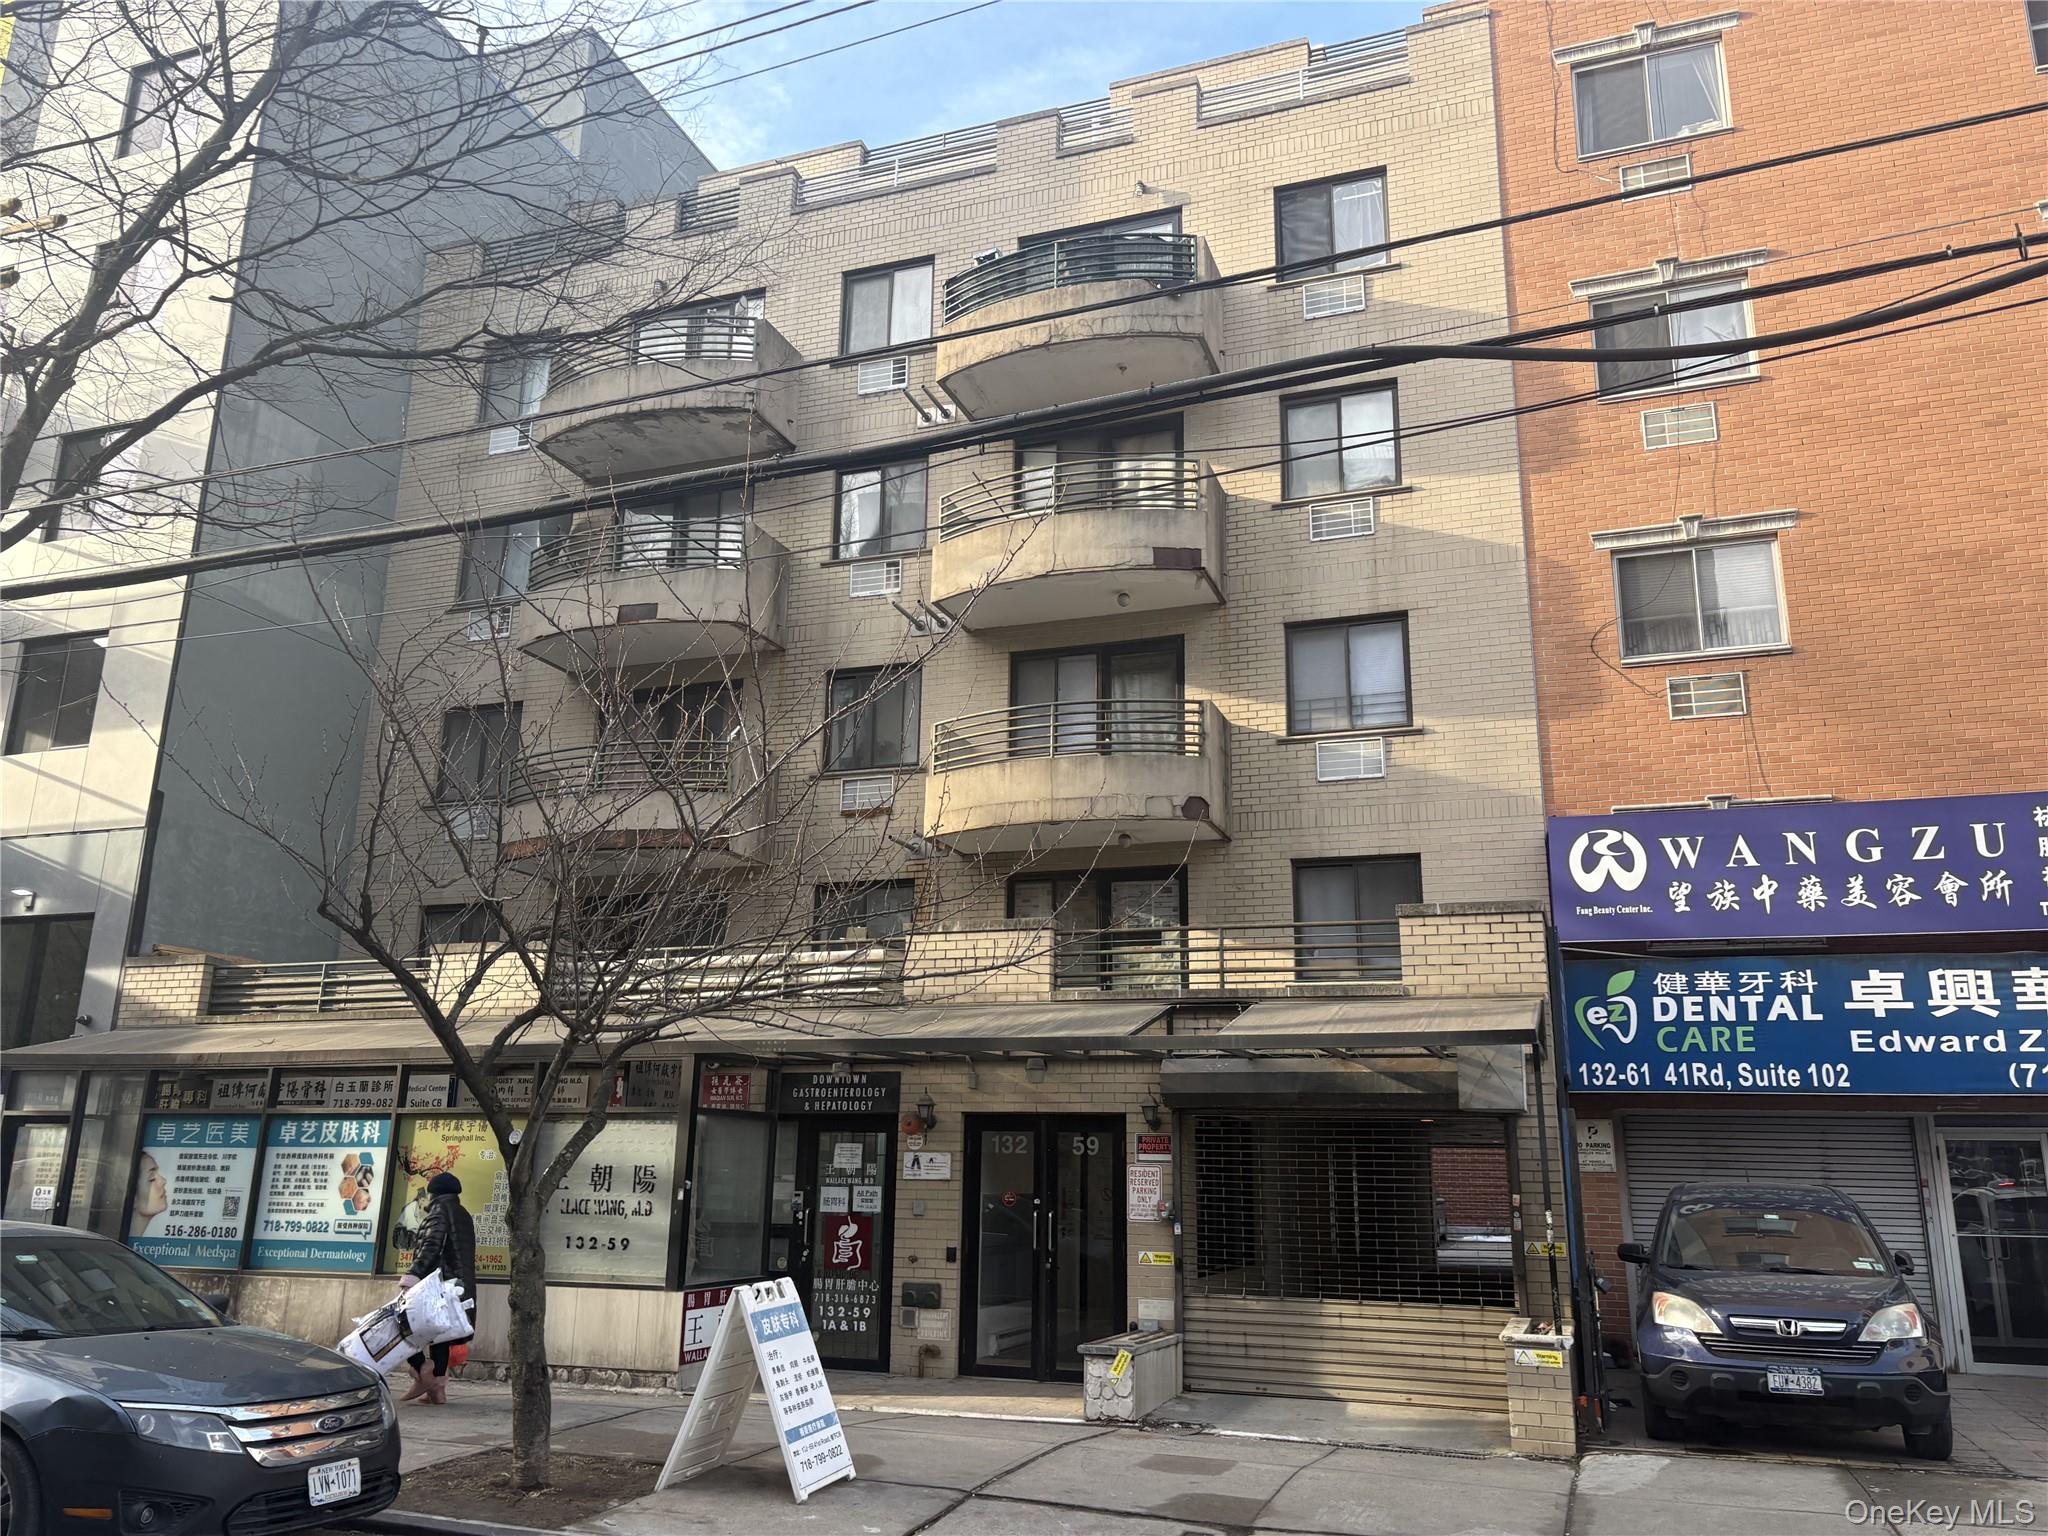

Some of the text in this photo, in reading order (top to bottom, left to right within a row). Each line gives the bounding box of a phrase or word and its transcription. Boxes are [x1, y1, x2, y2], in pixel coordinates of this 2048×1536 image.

[1658, 822, 2006, 870] WANGZU
[1668, 869, 2013, 915] 望族中藥美容會所
[1576, 904, 1653, 917] Fang Beauty Center Inc.
[1653, 969, 1818, 995] 健華牙科
[1653, 994, 1824, 1022] DENTAL
[1656, 1026, 1756, 1053] CARE
[1850, 1029, 2007, 1053] Edward
[813, 1074, 868, 1085] DOWNTOWN
[1578, 1062, 1851, 1091] 132-61 41Rd, Suite 102
[335, 1080, 394, 1093] 白玉蘭診所
[792, 1087, 887, 1098] GASTROENTEROLOGY
[410, 1098, 430, 1108] Suite
[804, 1101, 873, 1111] & HEPATOLOGY
[156, 1121, 250, 1144] 卓艺医美
[278, 1120, 381, 1144] 卓艺皮肤科
[441, 1134, 474, 1143] Springhall
[991, 1135, 1099, 1156] 132 59
[1141, 1136, 1169, 1144] PRIVATE
[1130, 1169, 1159, 1178] RESIDENT
[1129, 1178, 1160, 1186] RESERVED
[1132, 1187, 1157, 1195] PARKING
[1137, 1195, 1152, 1204] ONLY
[164, 1224, 238, 1239] 516-286-0180
[263, 1220, 330, 1233] 718-799-0822
[565, 1235, 630, 1251] 132-59
[133, 1242, 236, 1262] Exceptional Medspa
[258, 1246, 368, 1262] Exceptional Dermatology
[814, 1292, 876, 1304] 718-316-6873
[819, 1305, 871, 1318] 132-59
[760, 1312, 800, 1336] 皮肤专科
[822, 1319, 867, 1332] 1A & 1B
[800, 1444, 844, 1473] 718-799-0822
